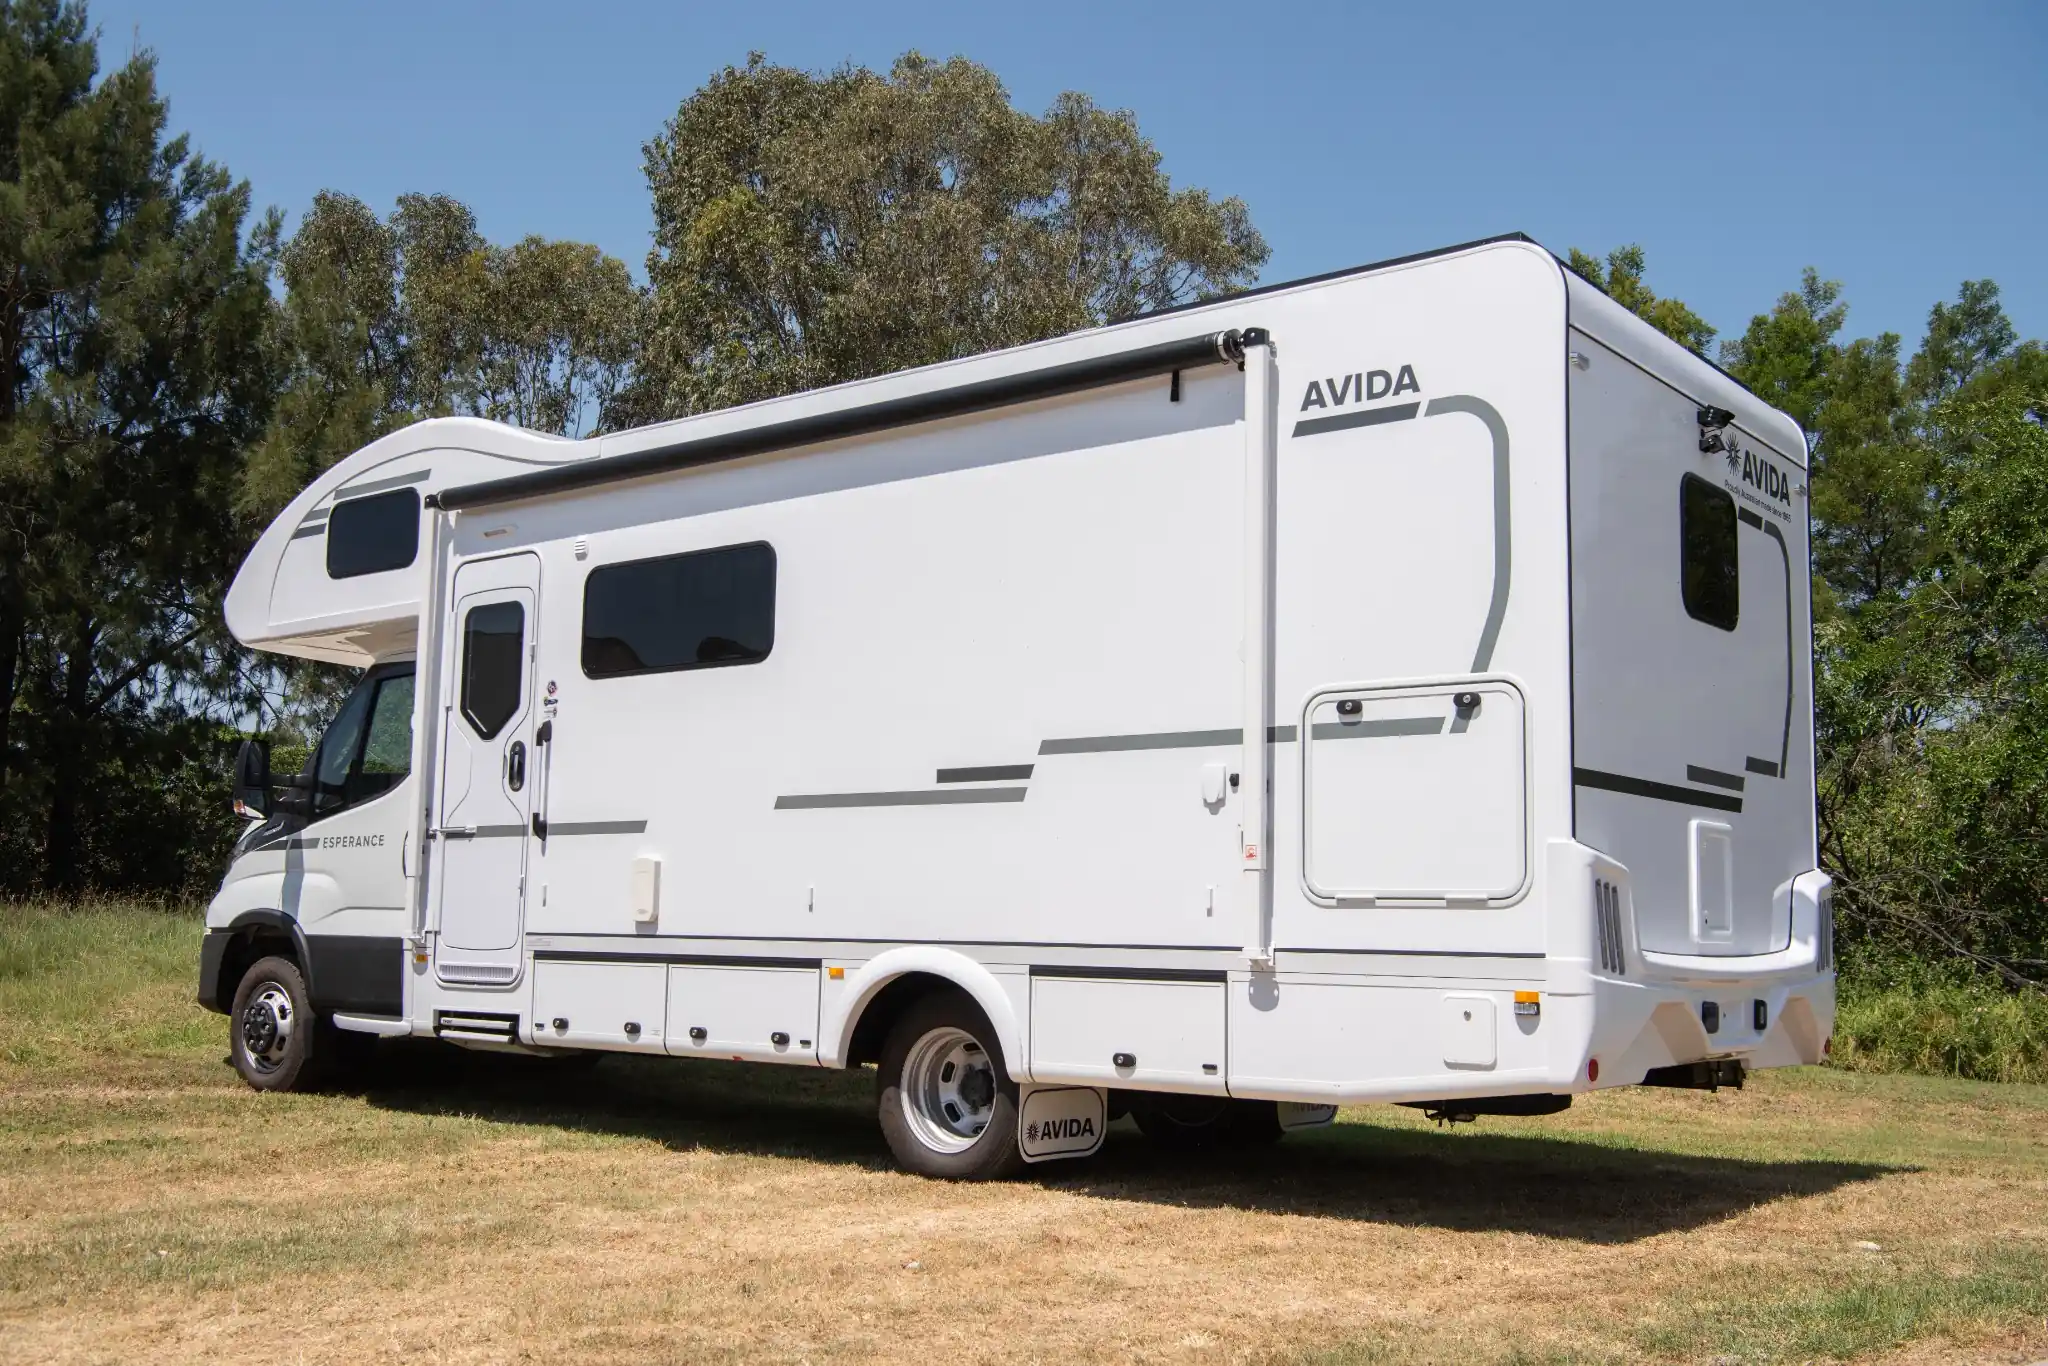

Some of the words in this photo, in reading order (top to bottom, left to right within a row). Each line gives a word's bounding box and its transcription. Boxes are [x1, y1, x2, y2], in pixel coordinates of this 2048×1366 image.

[1300, 364, 1421, 412] AVIDA
[1742, 449, 1791, 507] AVIDA
[323, 834, 385, 848] ESPERANCE
[1041, 1118, 1095, 1140] AVIDA
